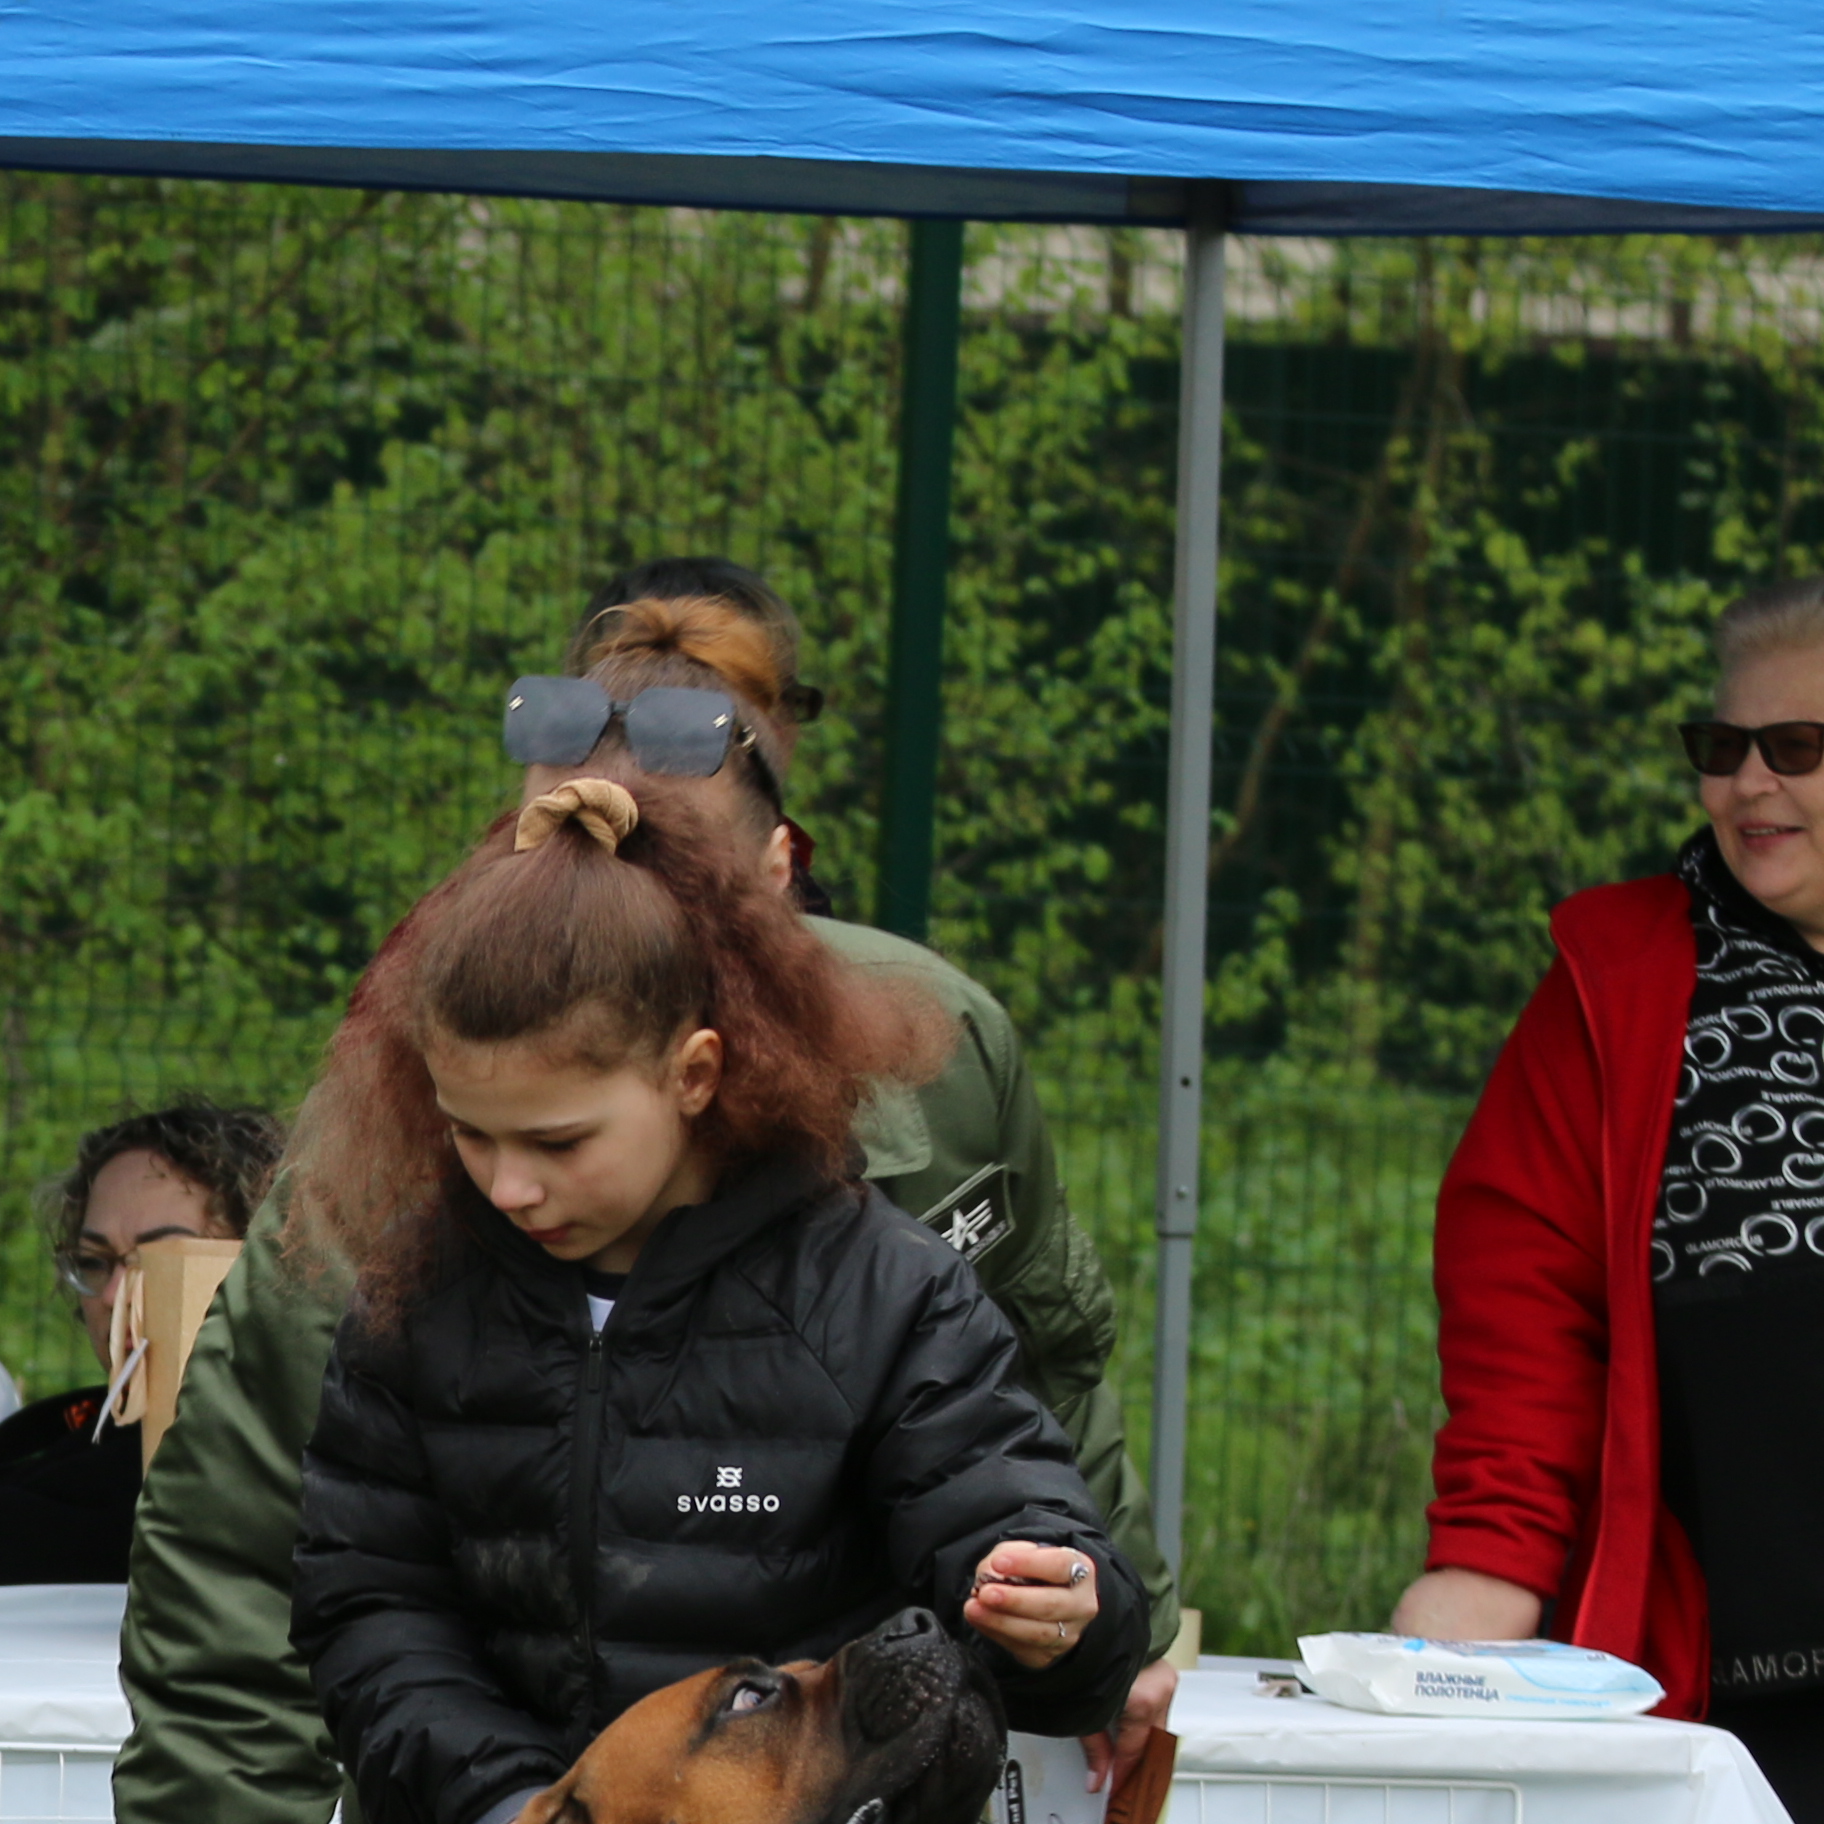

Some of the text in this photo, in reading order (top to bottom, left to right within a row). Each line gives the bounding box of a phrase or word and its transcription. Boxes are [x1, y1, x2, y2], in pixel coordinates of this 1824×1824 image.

[677, 1494, 780, 1512] svasso
[1415, 1670, 1486, 1687] ВЛАЖНЫЕ
[1414, 1685, 1500, 1702] ПОЛОТЕНЦА
